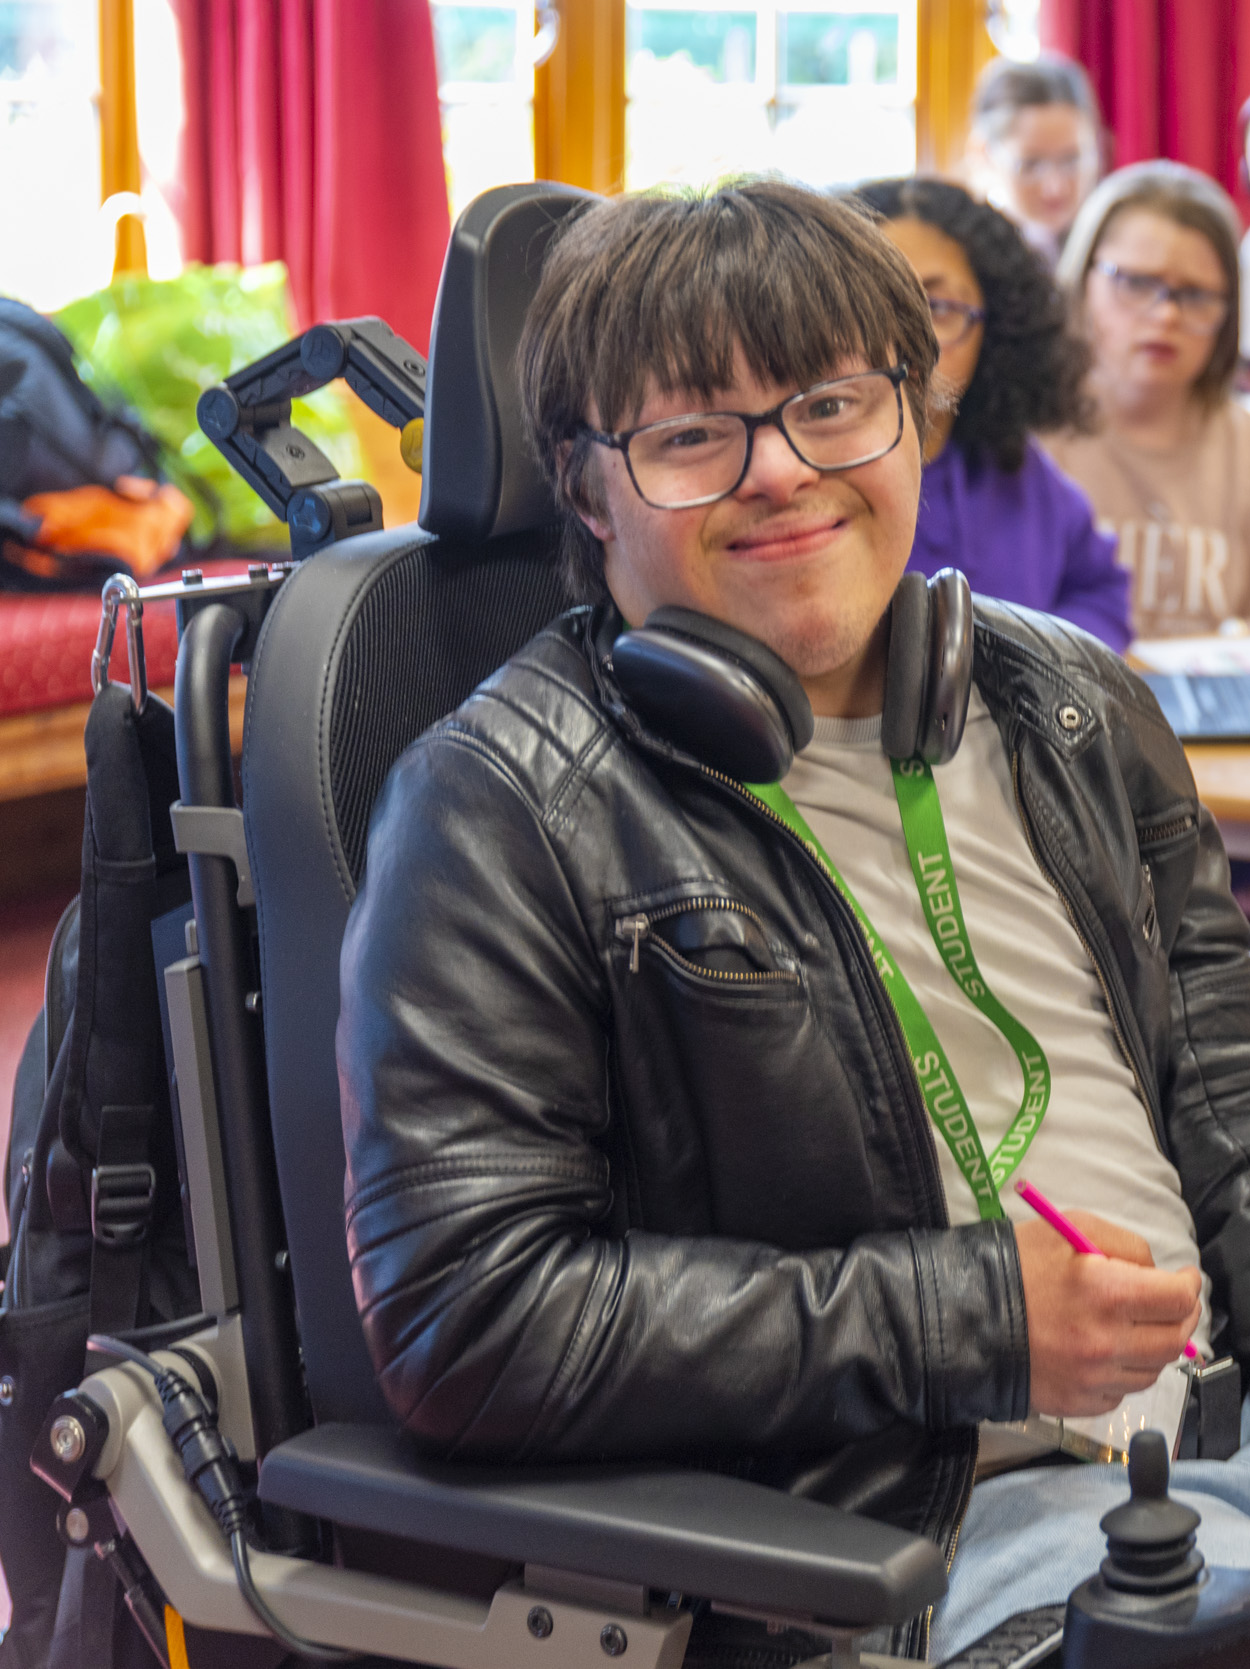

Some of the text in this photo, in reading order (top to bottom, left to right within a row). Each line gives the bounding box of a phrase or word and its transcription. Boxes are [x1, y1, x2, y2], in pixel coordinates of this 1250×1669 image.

[918, 851, 986, 998] STUDENT
[914, 1050, 993, 1199] STUDENT
[990, 1051, 1046, 1186] STUDENT
